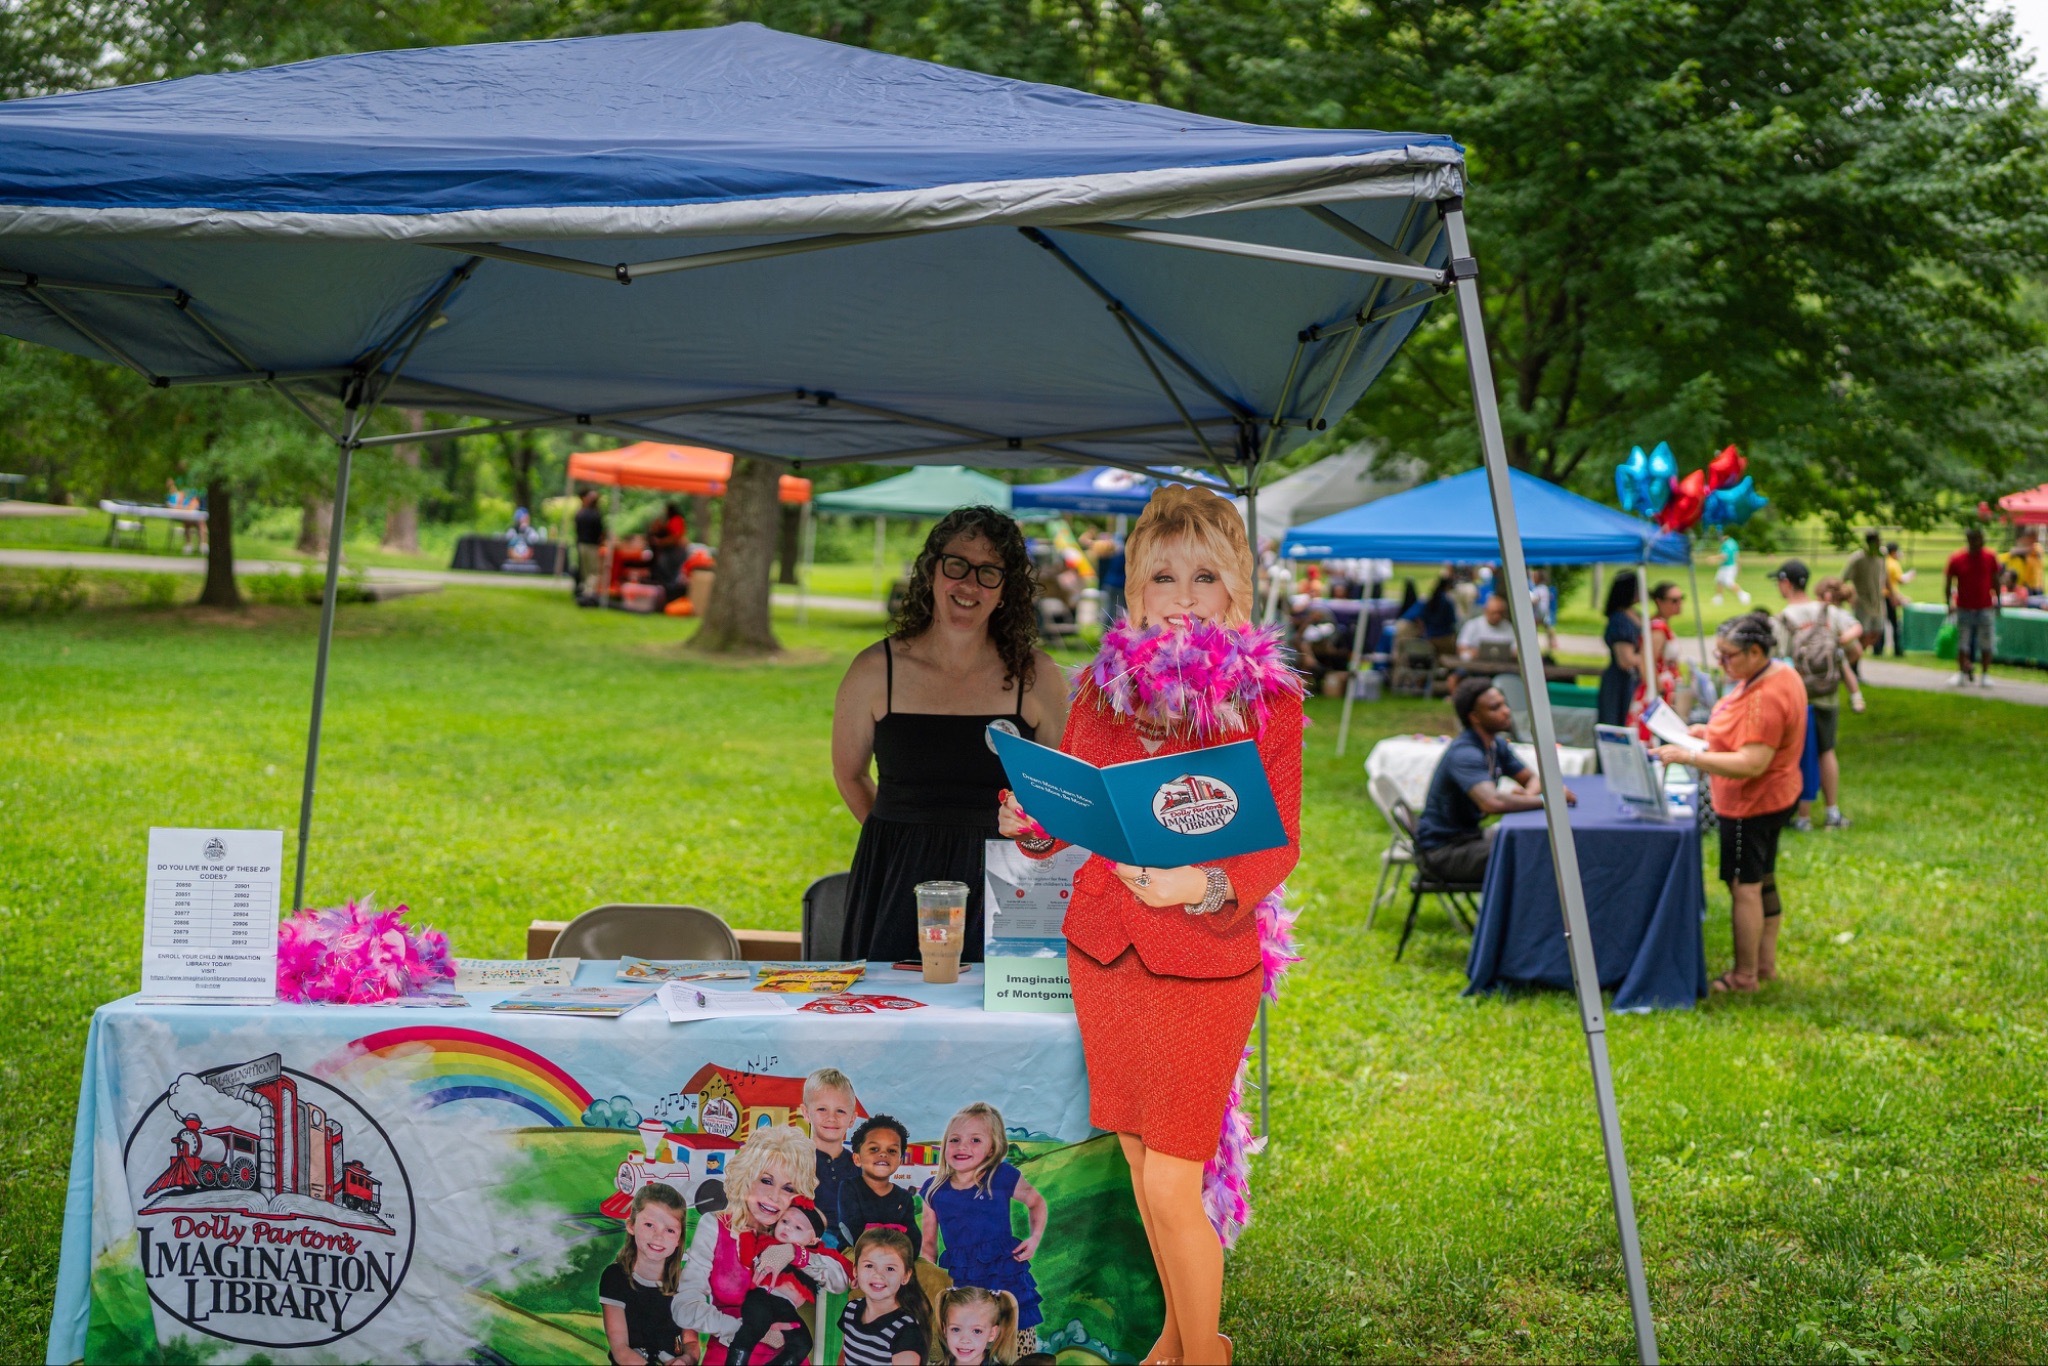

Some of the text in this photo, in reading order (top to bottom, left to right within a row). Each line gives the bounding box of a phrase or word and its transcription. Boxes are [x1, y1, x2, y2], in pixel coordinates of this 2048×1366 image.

[1022, 772, 1041, 784] Dream
[1161, 805, 1236, 828] IMAGINATION
[1180, 816, 1227, 834] LIBRARY
[996, 989, 1009, 998] of
[210, 1060, 275, 1087] IMAGINATION
[172, 1213, 362, 1256] Dolly Parton's
[136, 1226, 396, 1296] IMAGINATION
[184, 1278, 353, 1333] LIBRARY
